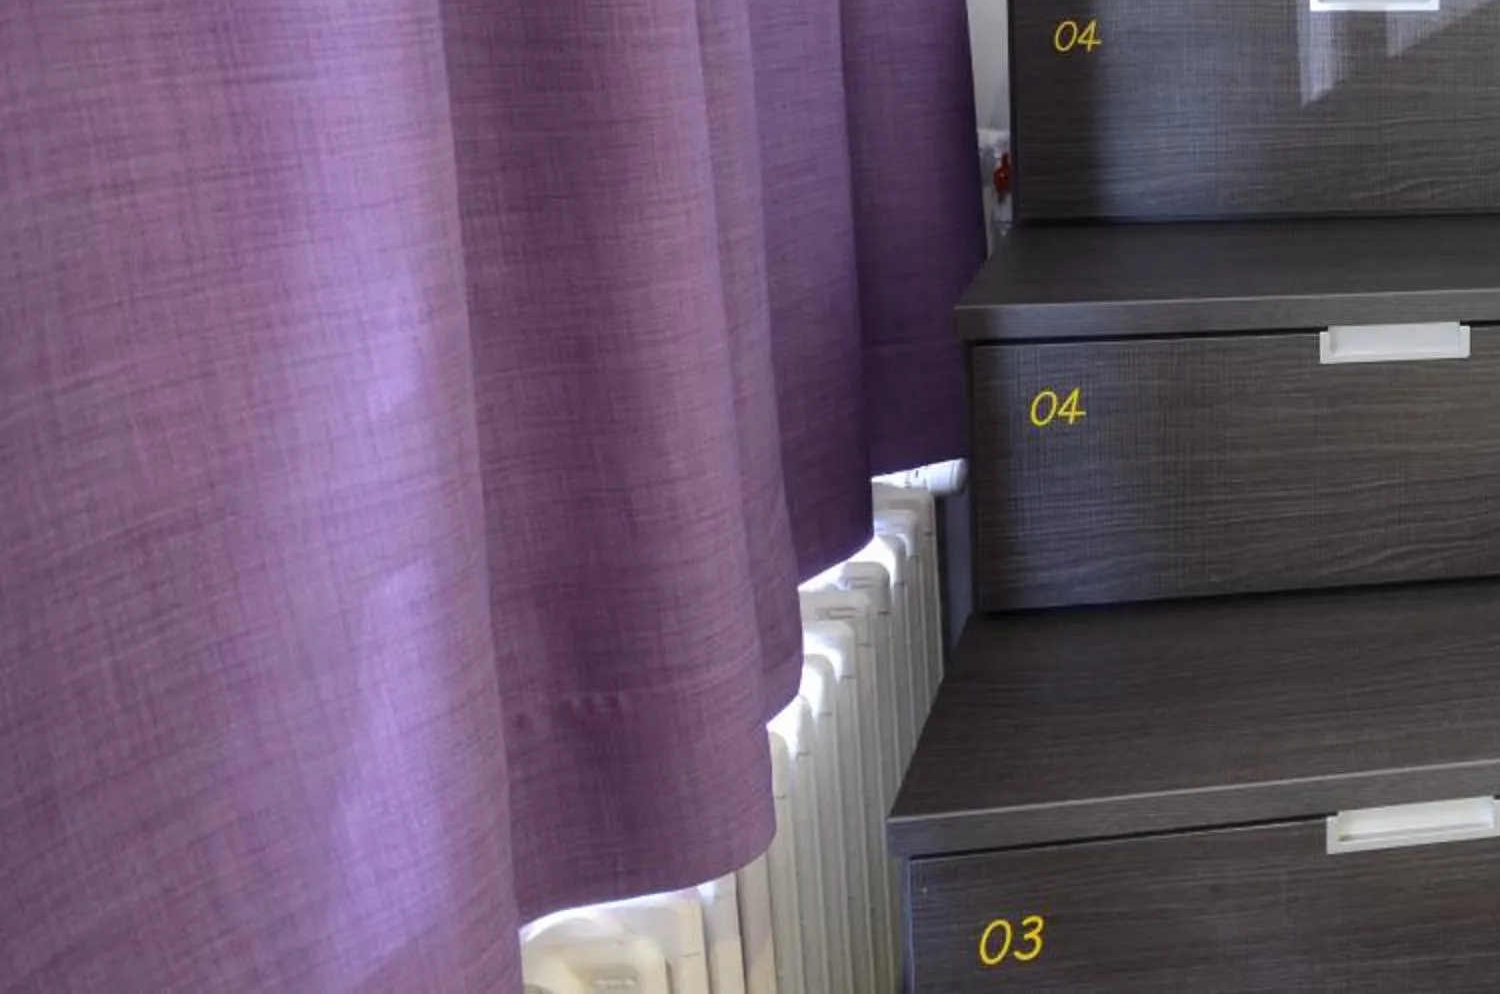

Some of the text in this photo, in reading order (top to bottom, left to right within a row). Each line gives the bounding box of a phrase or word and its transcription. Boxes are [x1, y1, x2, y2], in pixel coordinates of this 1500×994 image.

[1052, 19, 1102, 54] 04
[1029, 387, 1086, 427] 04
[979, 913, 1046, 967] 03
